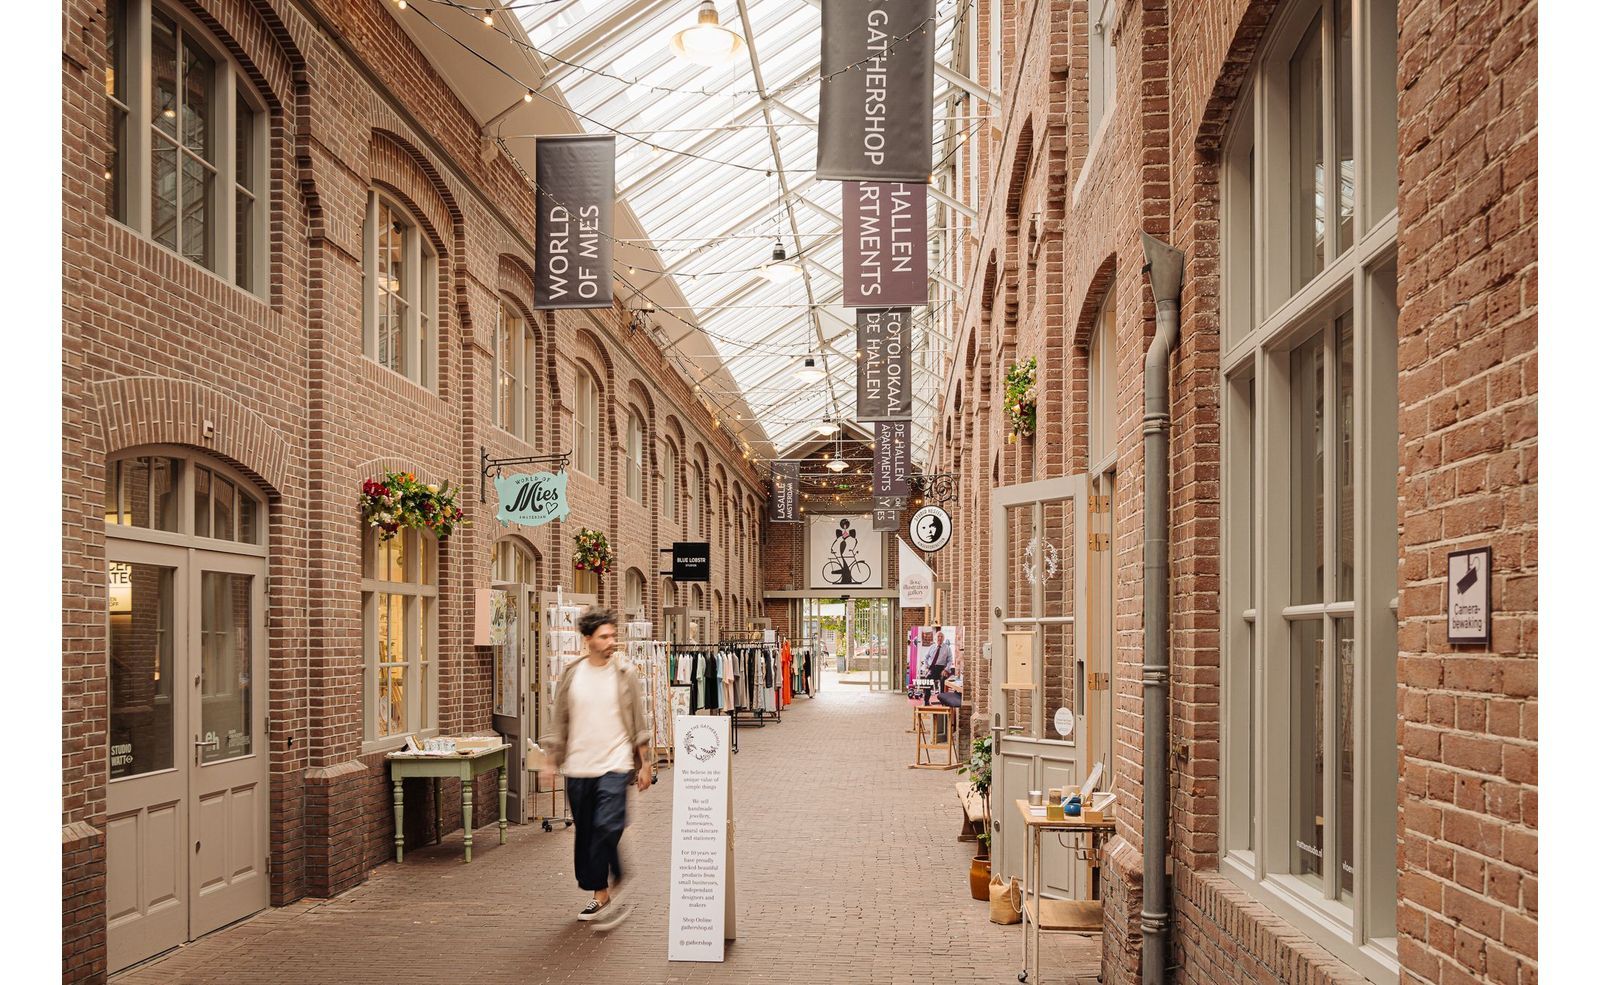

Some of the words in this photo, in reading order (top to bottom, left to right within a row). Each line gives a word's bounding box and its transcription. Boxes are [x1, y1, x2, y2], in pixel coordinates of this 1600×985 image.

[863, 9, 889, 165] GATHERSHOP
[579, 205, 599, 259] MIES
[859, 181, 882, 296] RTMENTS
[549, 205, 569, 300] WORLD
[578, 266, 598, 299] OF
[866, 313, 881, 333] DE
[866, 339, 881, 399] HALLEN
[887, 312, 902, 417] FOTOLOKAAL
[895, 423, 904, 437] DE
[881, 424, 891, 491] APARTMENTS
[895, 440, 904, 481] HALLEN
[505, 480, 559, 513] Mies
[515, 476, 539, 485] WORLD
[777, 482, 786, 519] LASALLE
[1452, 617, 1482, 632] bewaking
[1454, 603, 1481, 615] Camera-
[111, 743, 132, 756] STUDIO
